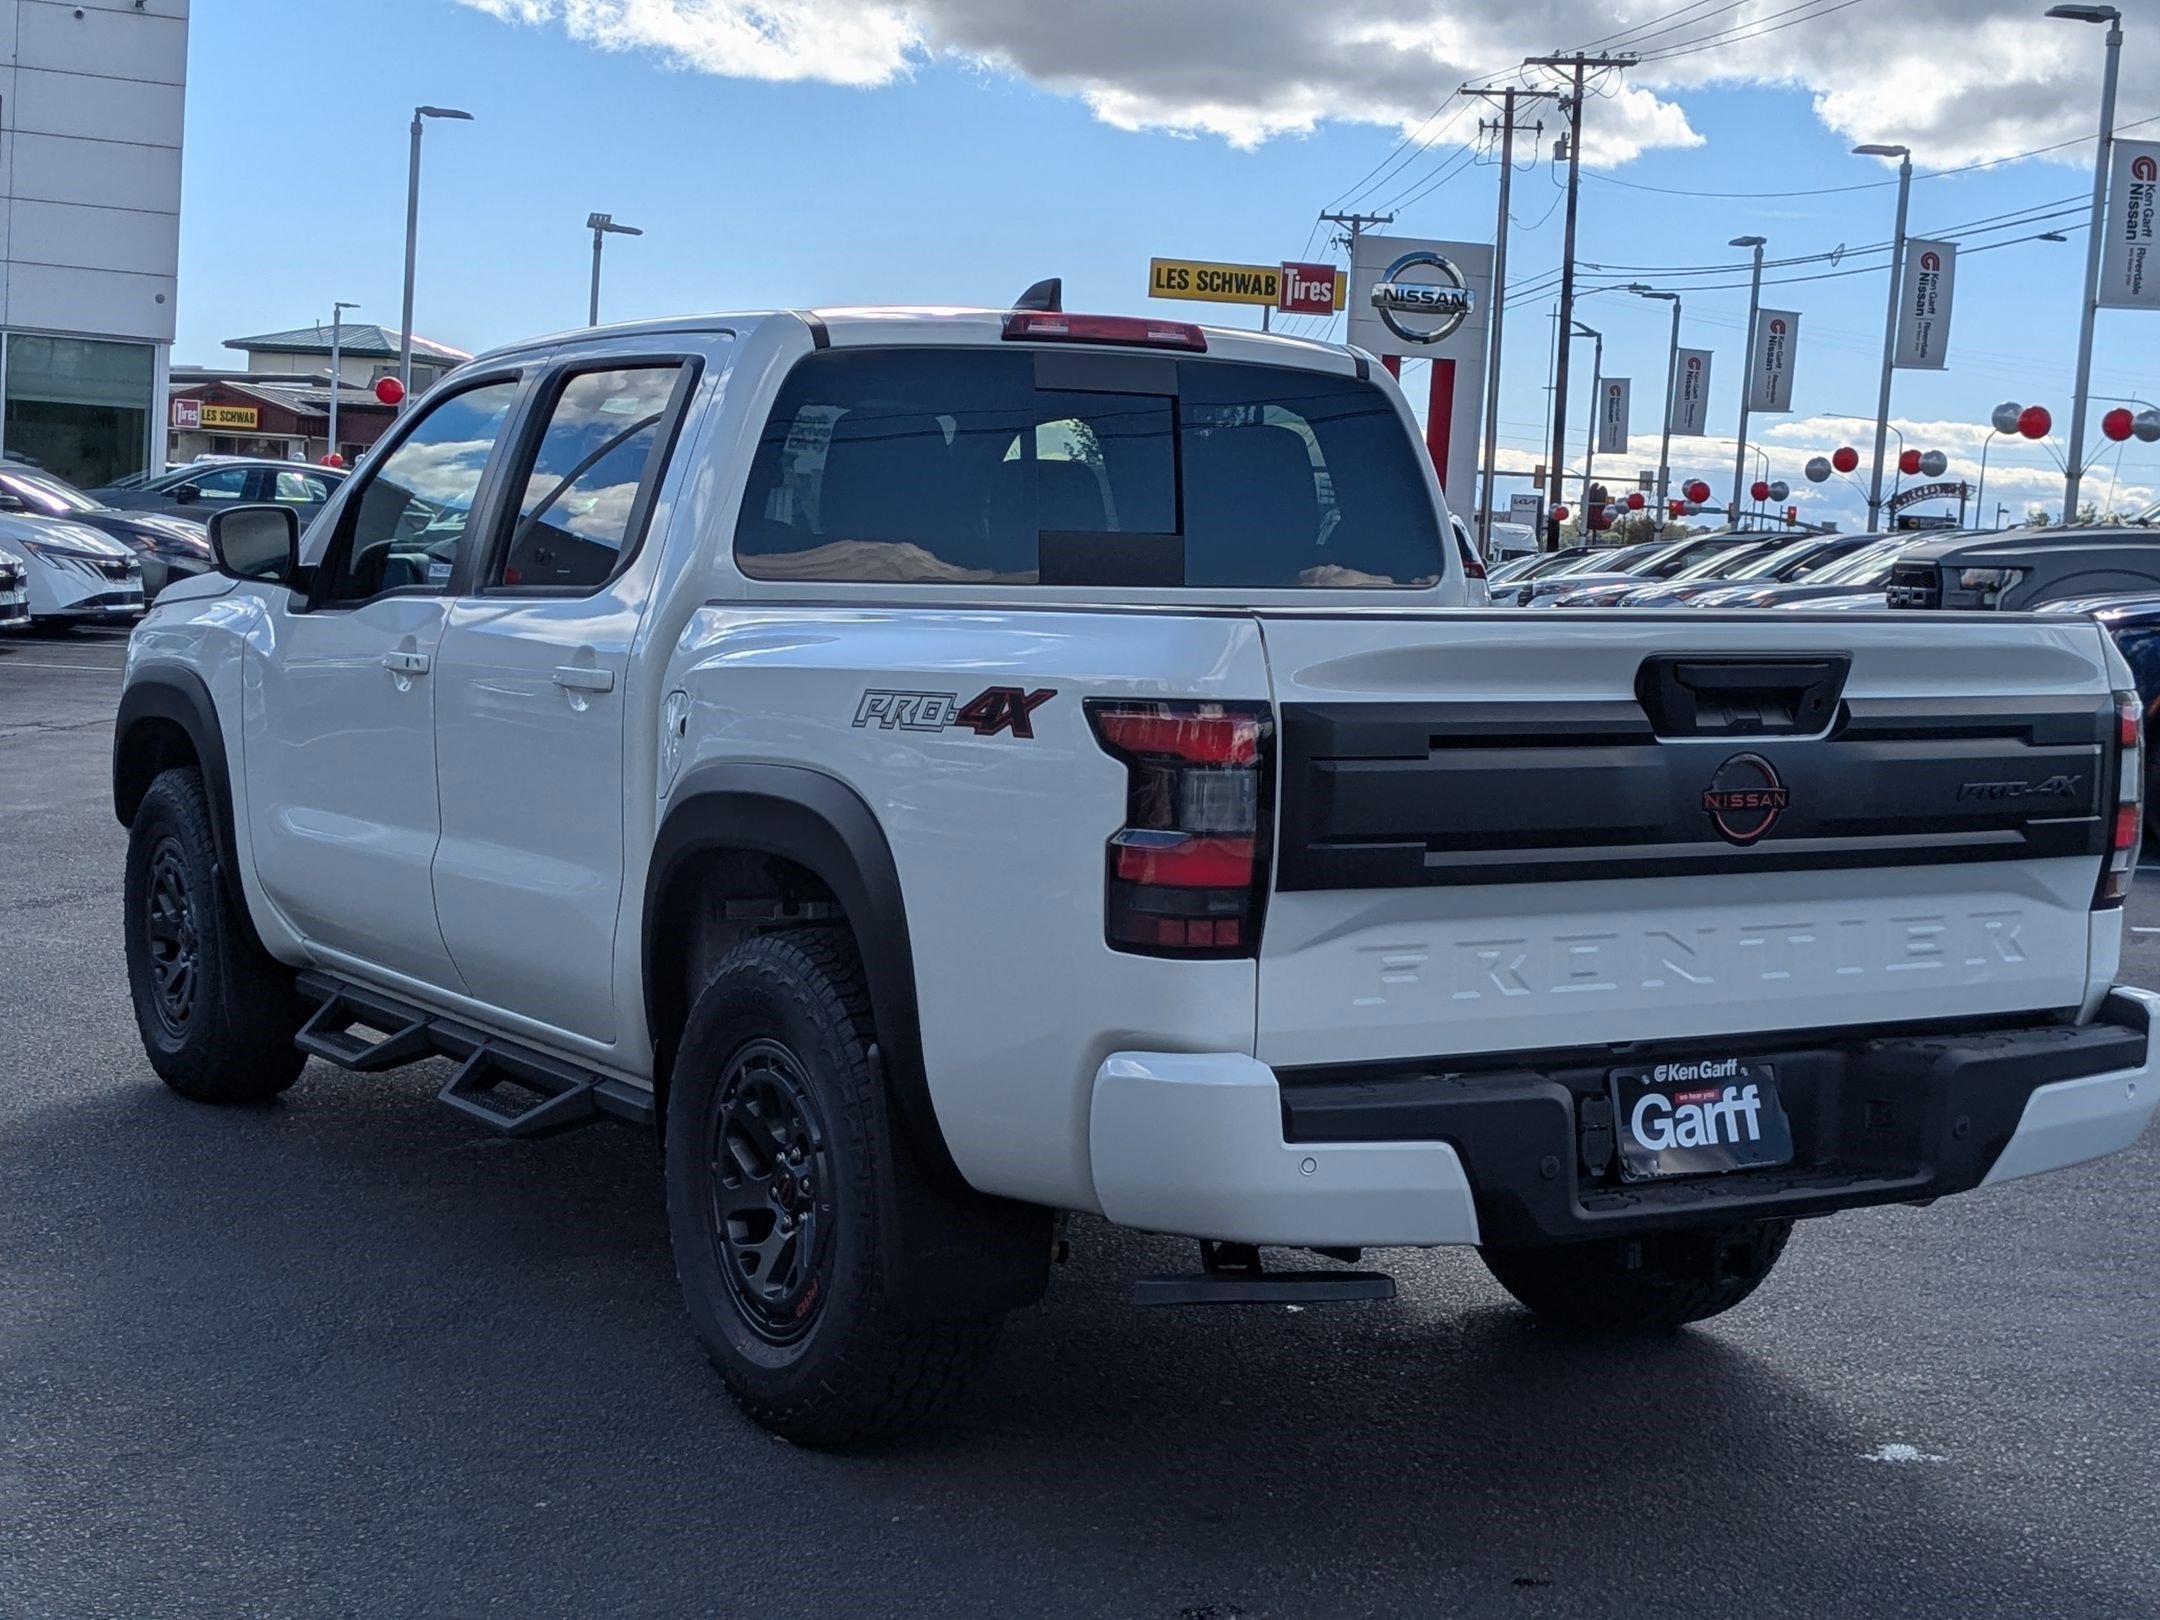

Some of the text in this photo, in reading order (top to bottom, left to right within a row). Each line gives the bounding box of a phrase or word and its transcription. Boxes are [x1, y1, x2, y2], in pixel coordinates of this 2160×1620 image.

[2125, 183, 2143, 241] Nissan
[2141, 183, 2156, 238] Ken Garff
[1155, 267, 1277, 296] LES SCHWAB
[1284, 267, 1332, 306] Tires
[2131, 247, 2147, 295] Riverdale
[1383, 288, 1466, 306] NISSAN
[1915, 272, 1931, 317] Nissan
[1927, 273, 1940, 315] Ken Garff
[1765, 335, 1777, 371] Nissan
[177, 402, 197, 424] Tires
[202, 409, 256, 424] LES SCHWAB
[1704, 793, 1786, 808] NISSAN
[1354, 910, 2027, 1006] FRONTIER
[1668, 1058, 1738, 1082] Ken Garff
[1631, 1084, 1761, 1151] Garff
